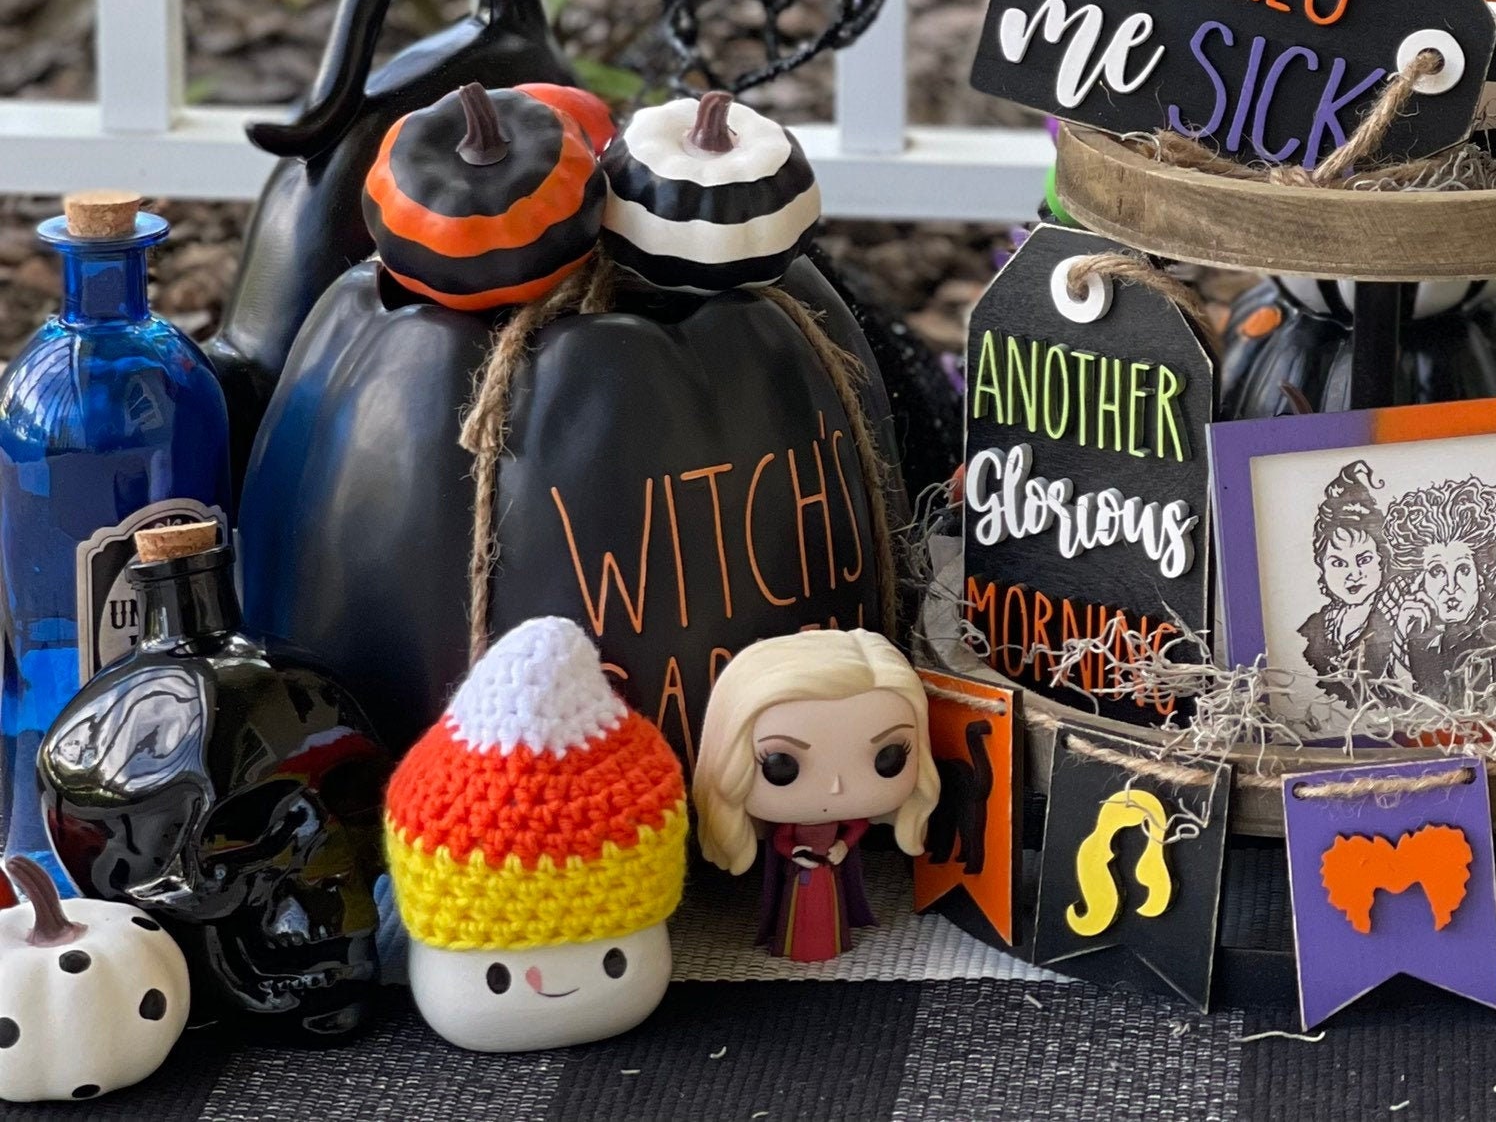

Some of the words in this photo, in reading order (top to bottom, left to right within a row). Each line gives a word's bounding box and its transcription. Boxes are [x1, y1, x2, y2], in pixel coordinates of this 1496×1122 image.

[1168, 20, 1387, 176] SICK
[974, 329, 1185, 462] ANOTHER
[551, 410, 863, 636] WITCH'S
